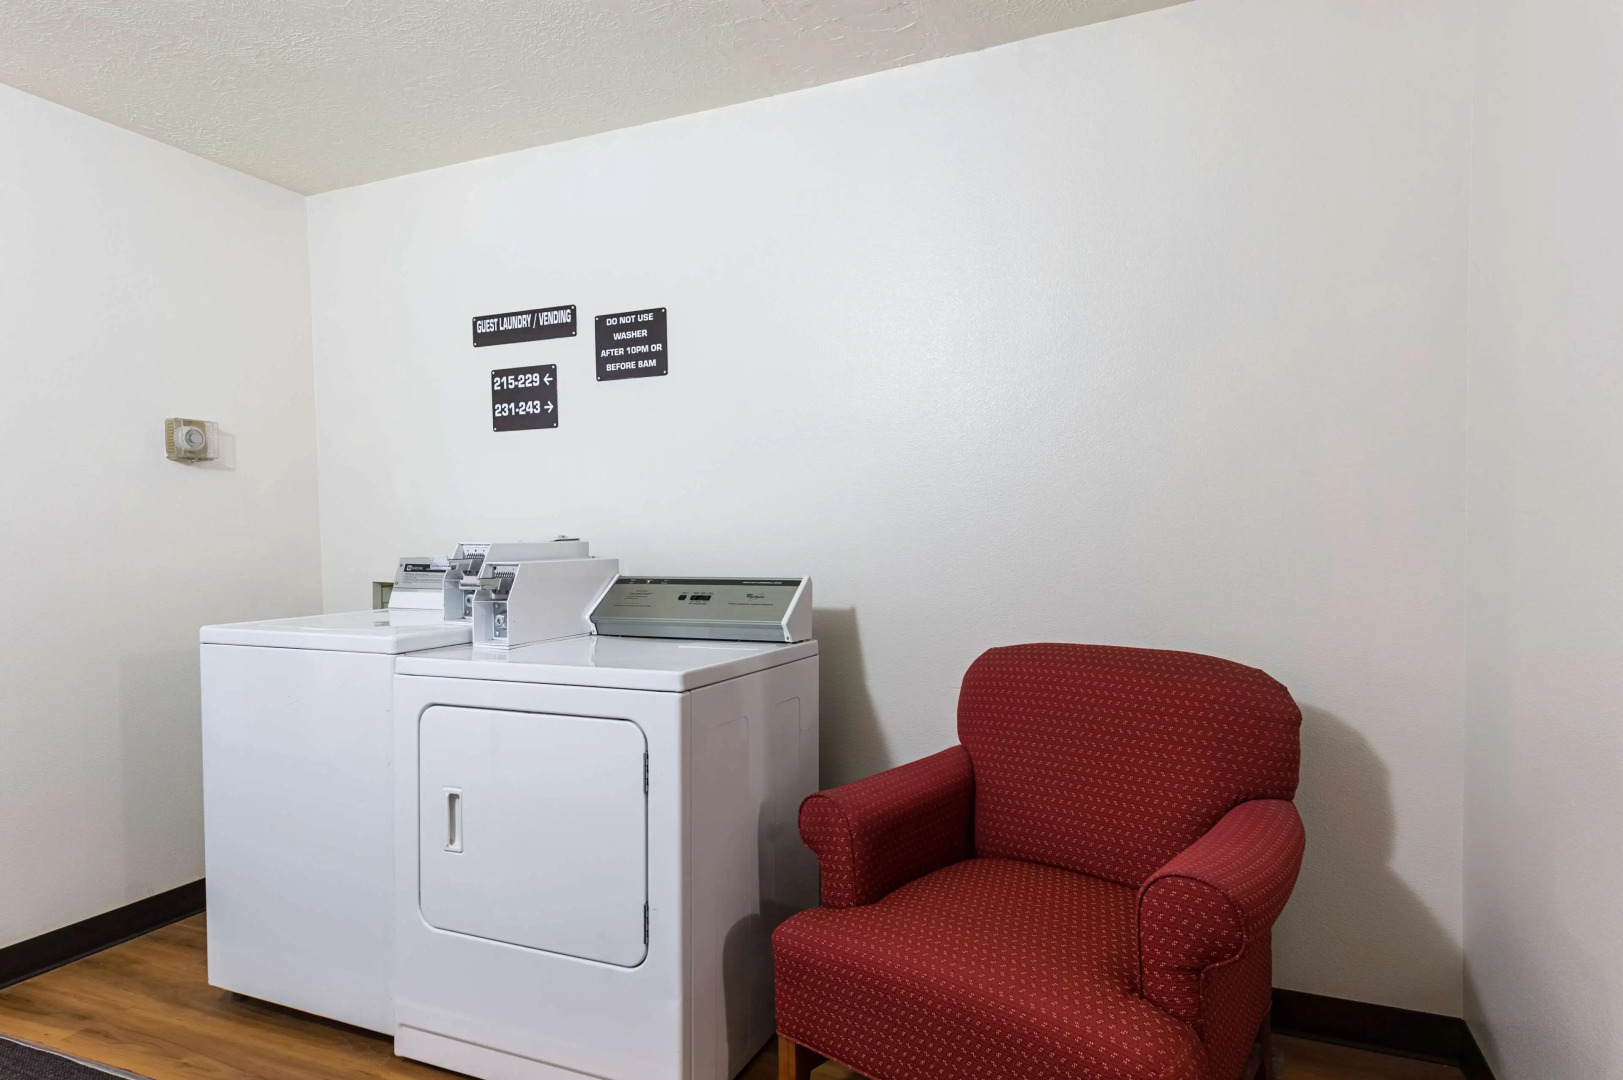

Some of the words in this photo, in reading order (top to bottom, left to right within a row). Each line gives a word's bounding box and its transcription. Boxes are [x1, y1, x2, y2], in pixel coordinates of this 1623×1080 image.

[477, 318, 498, 333] GUEST
[499, 314, 531, 330] LAUNDRY
[538, 309, 571, 325] VENDING
[607, 318, 617, 326] DO
[620, 315, 635, 324] NOT
[638, 313, 653, 321] USE
[613, 330, 647, 340] WASHER
[601, 348, 624, 357] AFTER
[626, 345, 648, 354] 10PM
[606, 361, 636, 371] BEFORE
[638, 359, 656, 368] 8AM
[494, 373, 539, 390] 215-229
[495, 400, 540, 417] 231-243
